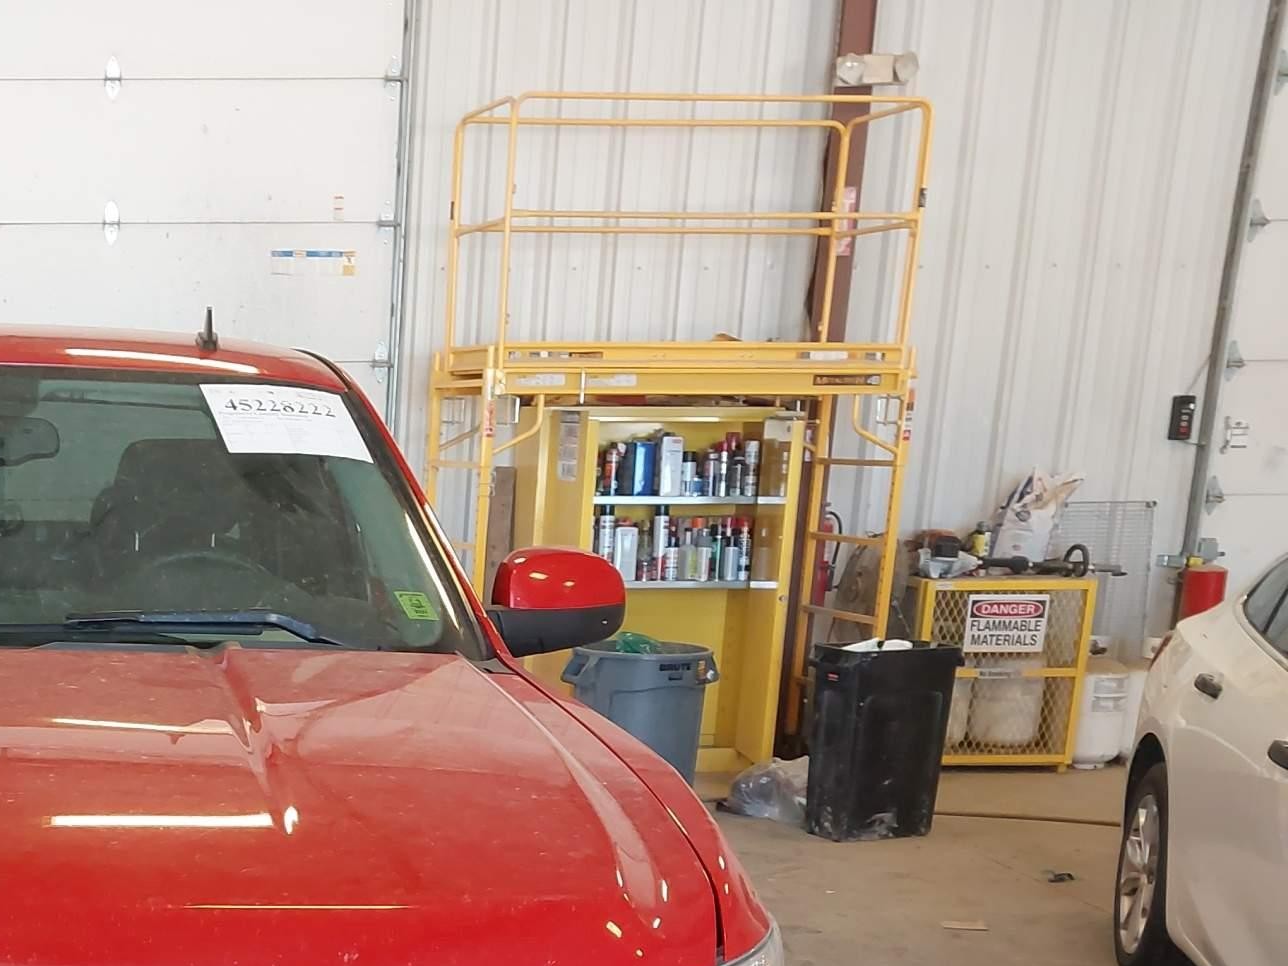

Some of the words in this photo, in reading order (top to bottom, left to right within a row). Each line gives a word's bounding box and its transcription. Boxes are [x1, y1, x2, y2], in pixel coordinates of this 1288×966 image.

[224, 398, 337, 418] 45228222
[980, 603, 1036, 615] DANGER
[970, 619, 1043, 632] FLAMMABLE
[970, 634, 1038, 646] MATERIALS
